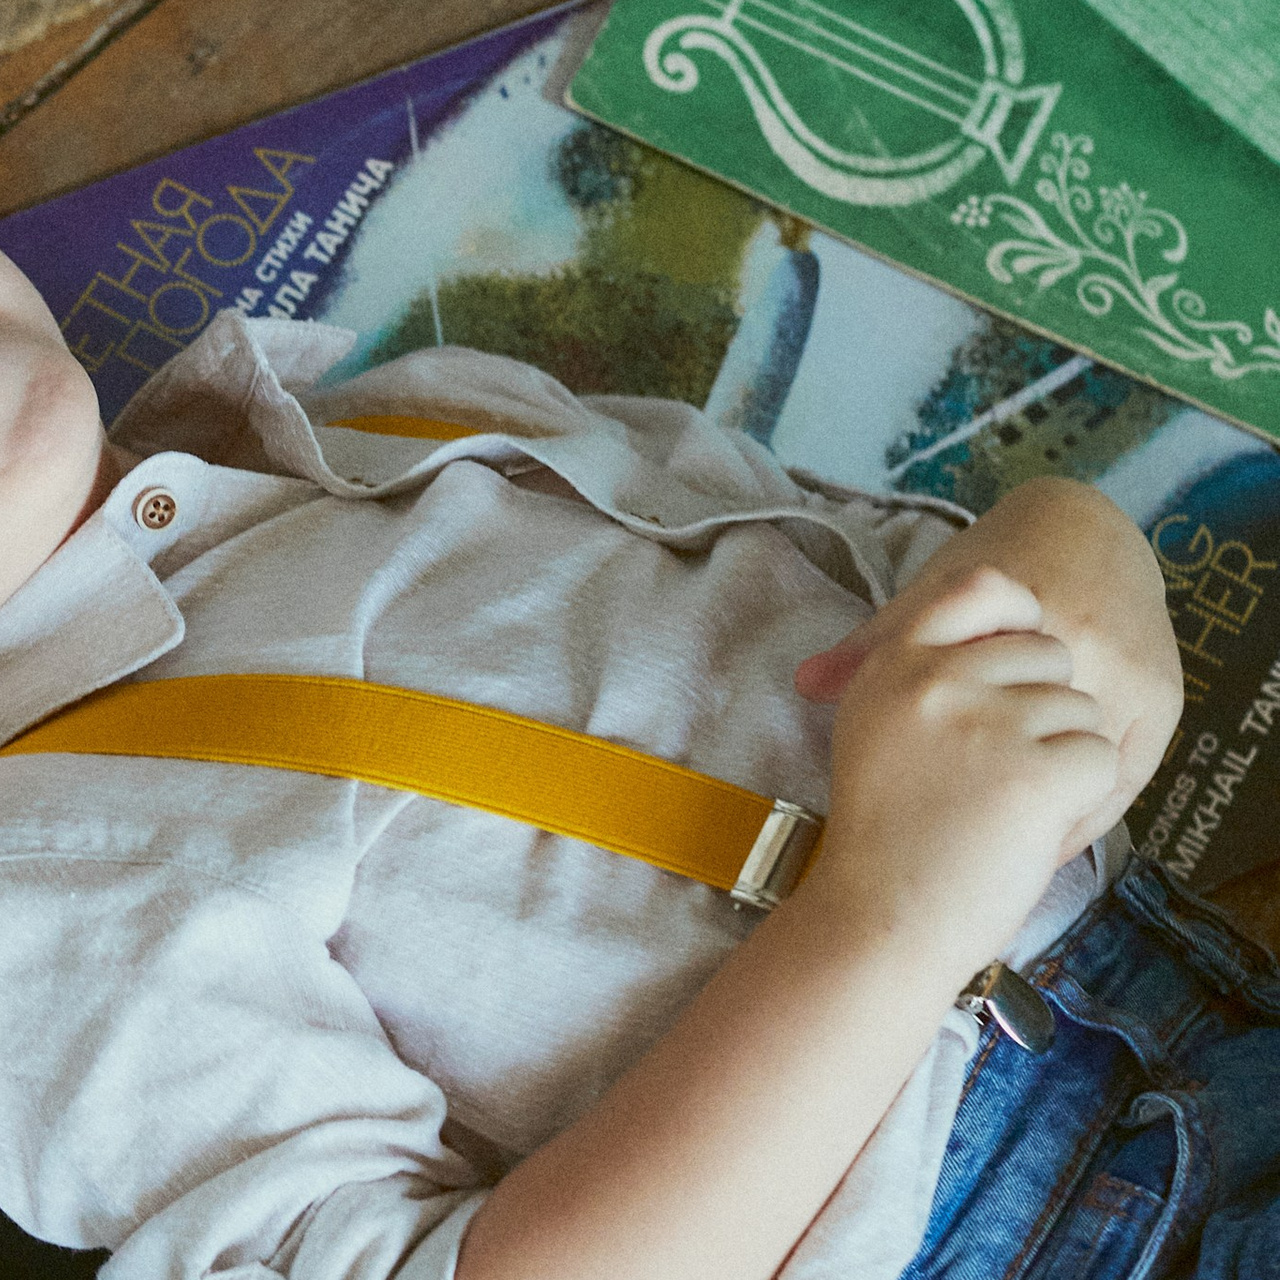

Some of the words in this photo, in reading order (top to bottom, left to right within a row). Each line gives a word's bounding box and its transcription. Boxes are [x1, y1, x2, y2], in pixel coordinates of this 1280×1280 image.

[57, 176, 214, 372] ЕТНАЯ
[114, 148, 317, 373] ПОГОДА
[254, 210, 314, 285] СТИХИ
[304, 153, 395, 266] ТАНИЧА
[1139, 772, 1198, 857] SONGS
[1187, 730, 1221, 769] TO
[1164, 739, 1258, 879] MIKHAIL
[1240, 660, 1280, 736] TAN
